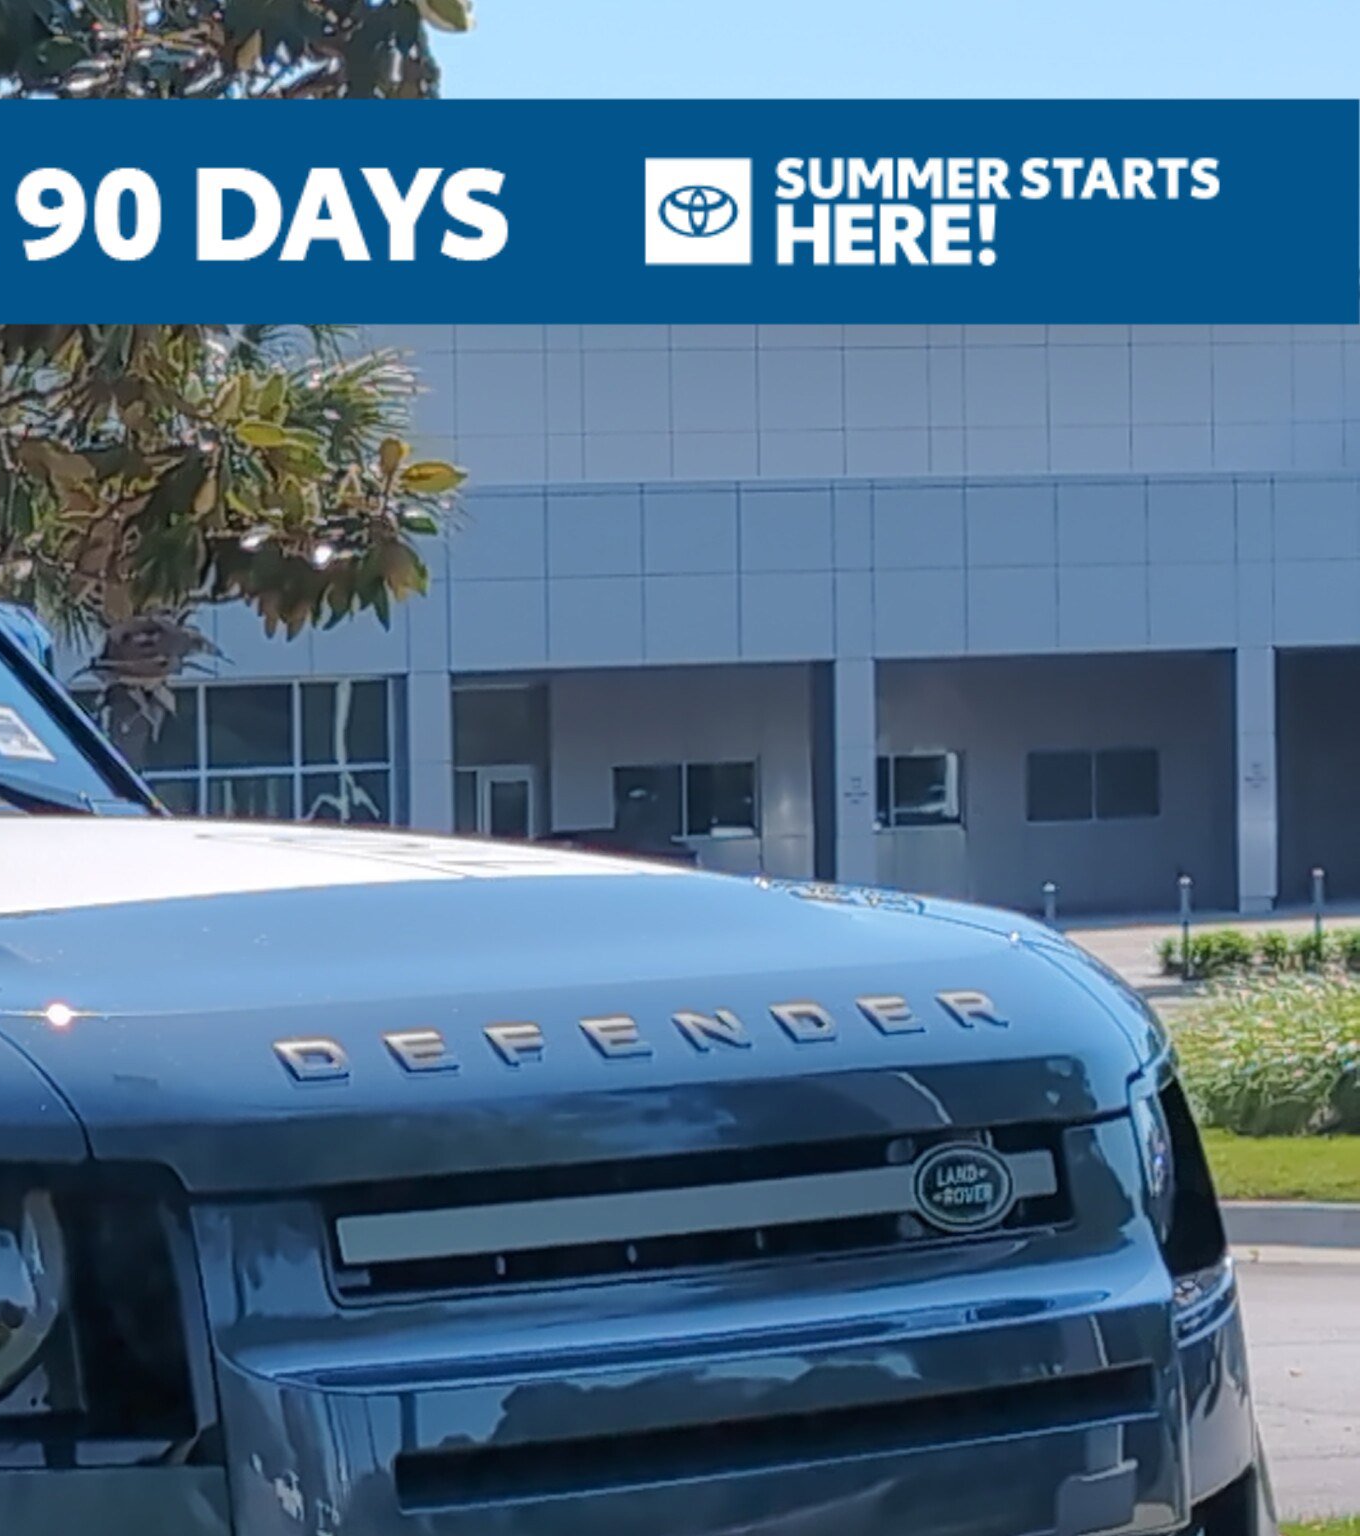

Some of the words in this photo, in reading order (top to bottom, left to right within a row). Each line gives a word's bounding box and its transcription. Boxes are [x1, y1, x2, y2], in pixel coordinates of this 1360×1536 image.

[272, 990, 1009, 1082] DEFENDER
[937, 1165, 978, 1187] LAND
[944, 1184, 993, 1204] ROVER
